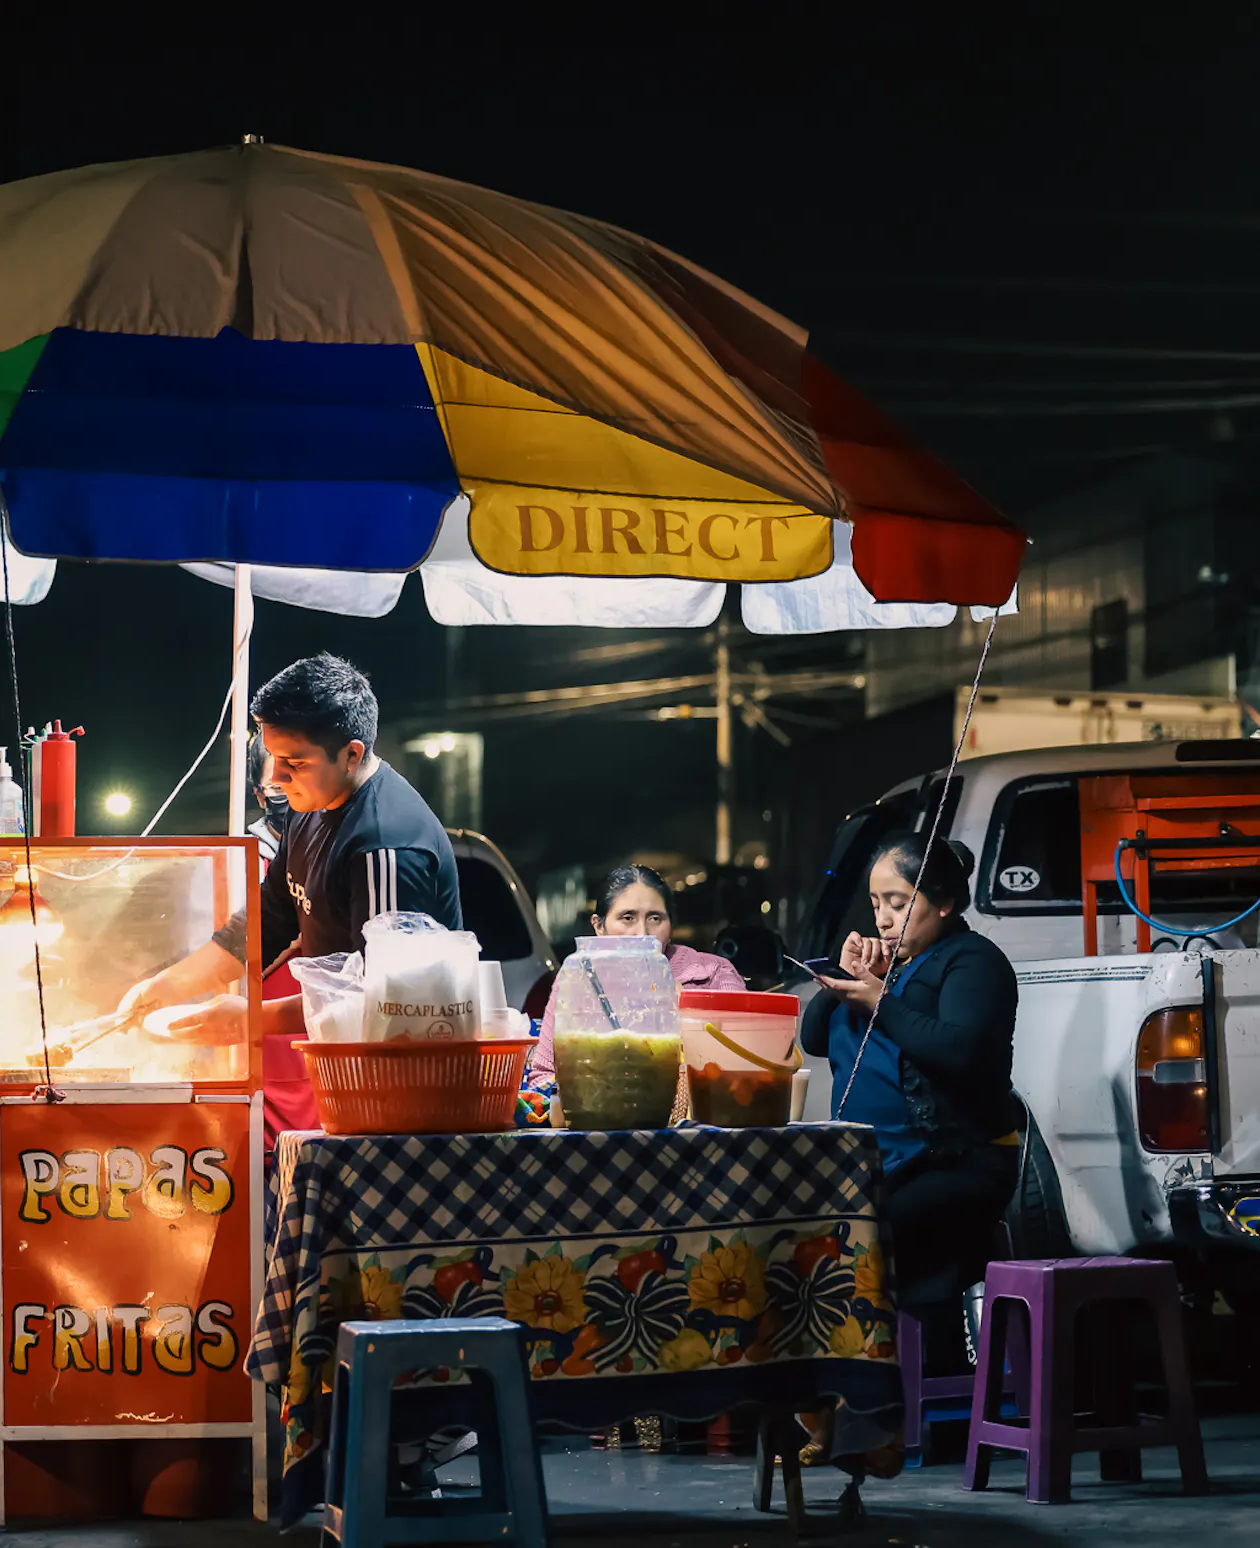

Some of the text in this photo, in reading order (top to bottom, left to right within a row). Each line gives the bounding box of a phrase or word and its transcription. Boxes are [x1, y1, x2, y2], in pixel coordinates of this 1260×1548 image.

[515, 505, 790, 562] DIRECT
[1004, 871, 1035, 885] TX
[377, 1000, 473, 1018] MERCAPLASTIC
